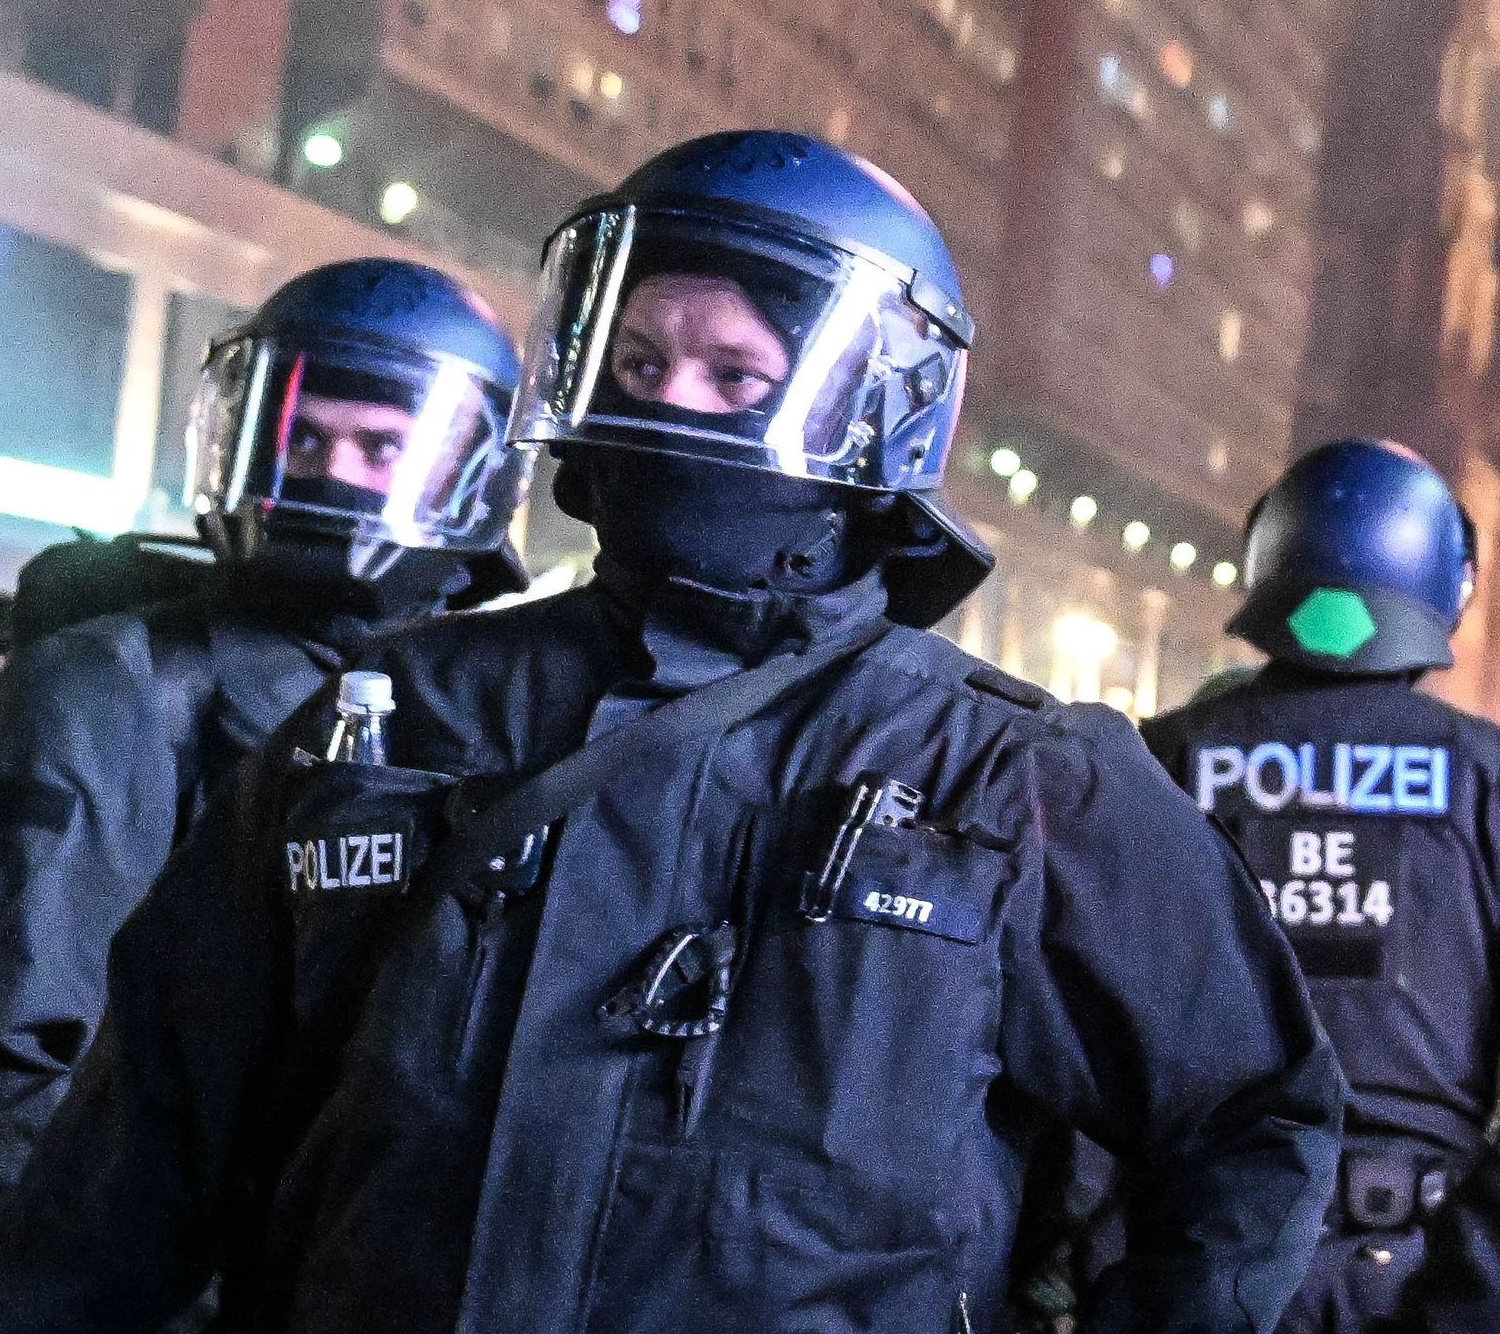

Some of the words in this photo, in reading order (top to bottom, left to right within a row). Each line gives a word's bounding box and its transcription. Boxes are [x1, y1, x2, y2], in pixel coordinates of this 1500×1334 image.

[1195, 741, 1450, 816] POLIZEI
[286, 832, 404, 892] POLIZEI
[1288, 830, 1357, 878] BE
[864, 890, 934, 923] 42977
